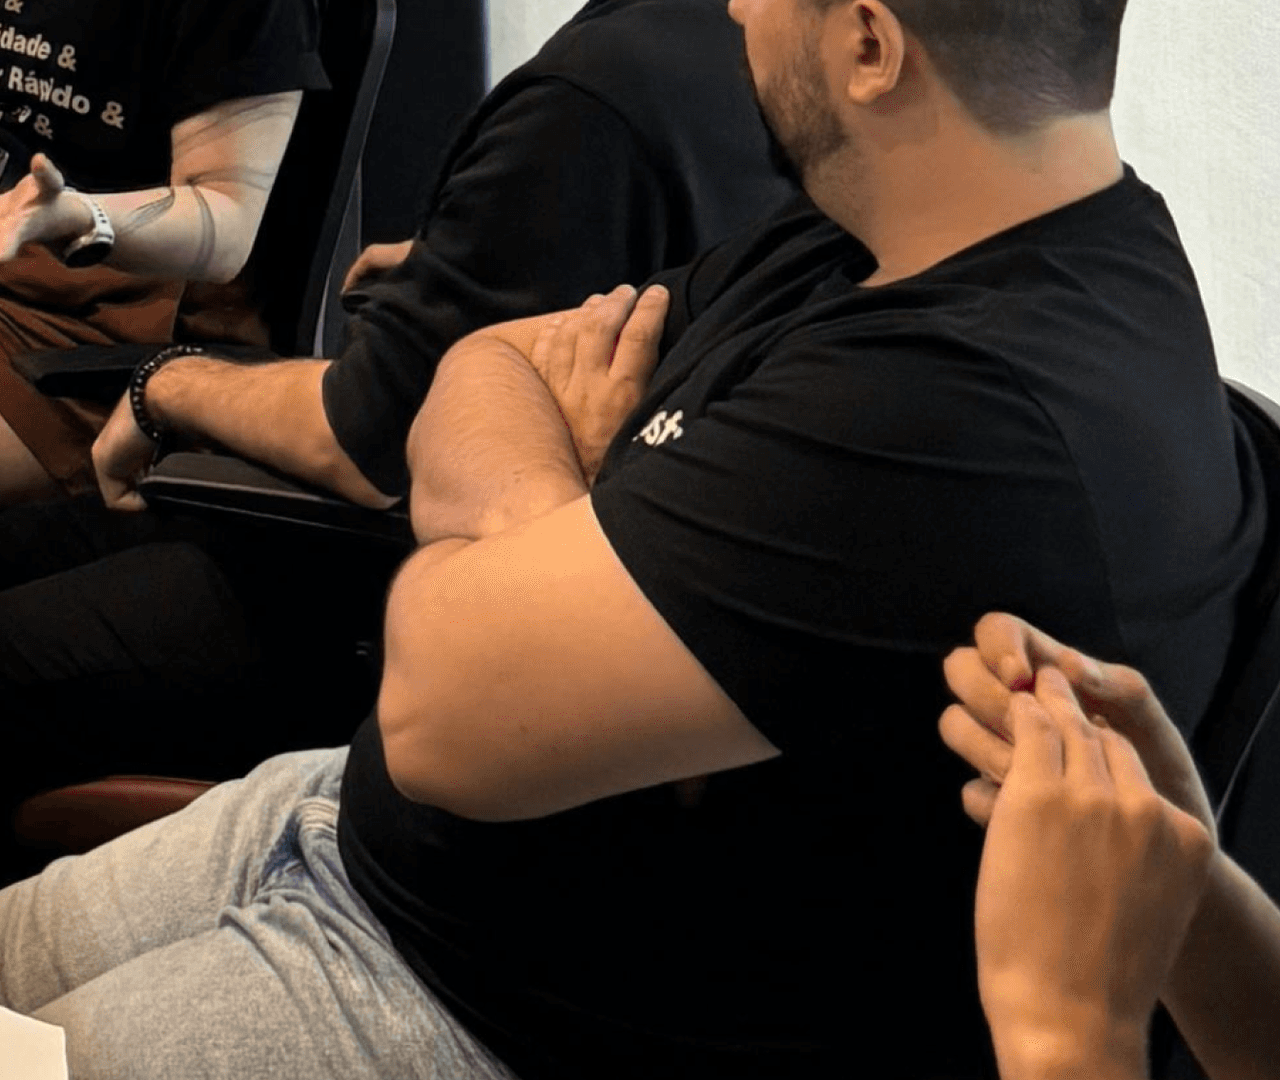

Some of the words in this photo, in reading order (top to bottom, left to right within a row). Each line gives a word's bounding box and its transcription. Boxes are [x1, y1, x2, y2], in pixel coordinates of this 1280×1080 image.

[57, 44, 77, 71] &
[34, 113, 54, 140] &
[101, 101, 125, 129] &
